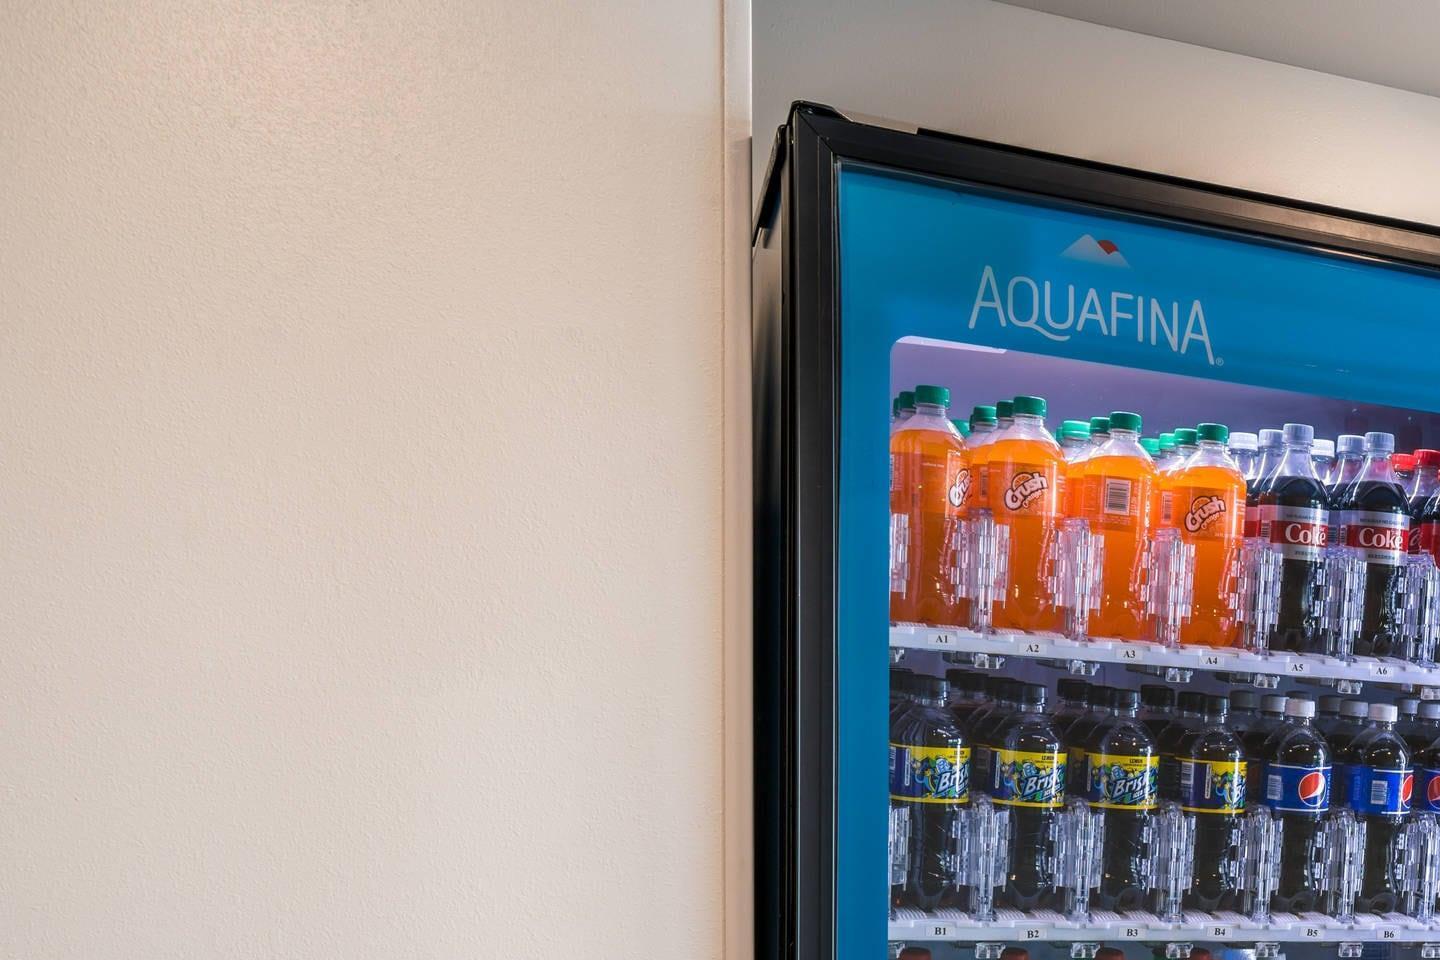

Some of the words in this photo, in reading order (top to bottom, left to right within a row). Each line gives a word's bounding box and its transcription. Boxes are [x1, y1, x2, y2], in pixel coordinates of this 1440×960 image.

[968, 265, 1215, 365] AQUAFINA
[1004, 472, 1048, 510] Crush
[1184, 495, 1226, 533] Crush
[1285, 523, 1326, 546] Coke
[1358, 528, 1404, 549] Coke
[935, 635, 948, 643] A1
[1026, 644, 1039, 653] A2
[1123, 650, 1136, 658] A3
[1205, 657, 1218, 665] A4
[1291, 663, 1304, 671] A5
[1376, 667, 1388, 675] A6
[934, 927, 947, 936] B1
[1027, 929, 1040, 939] B2
[1127, 928, 1138, 937] B3
[1214, 927, 1226, 936] B4
[1307, 928, 1318, 937] B5
[1383, 930, 1395, 939] B6
